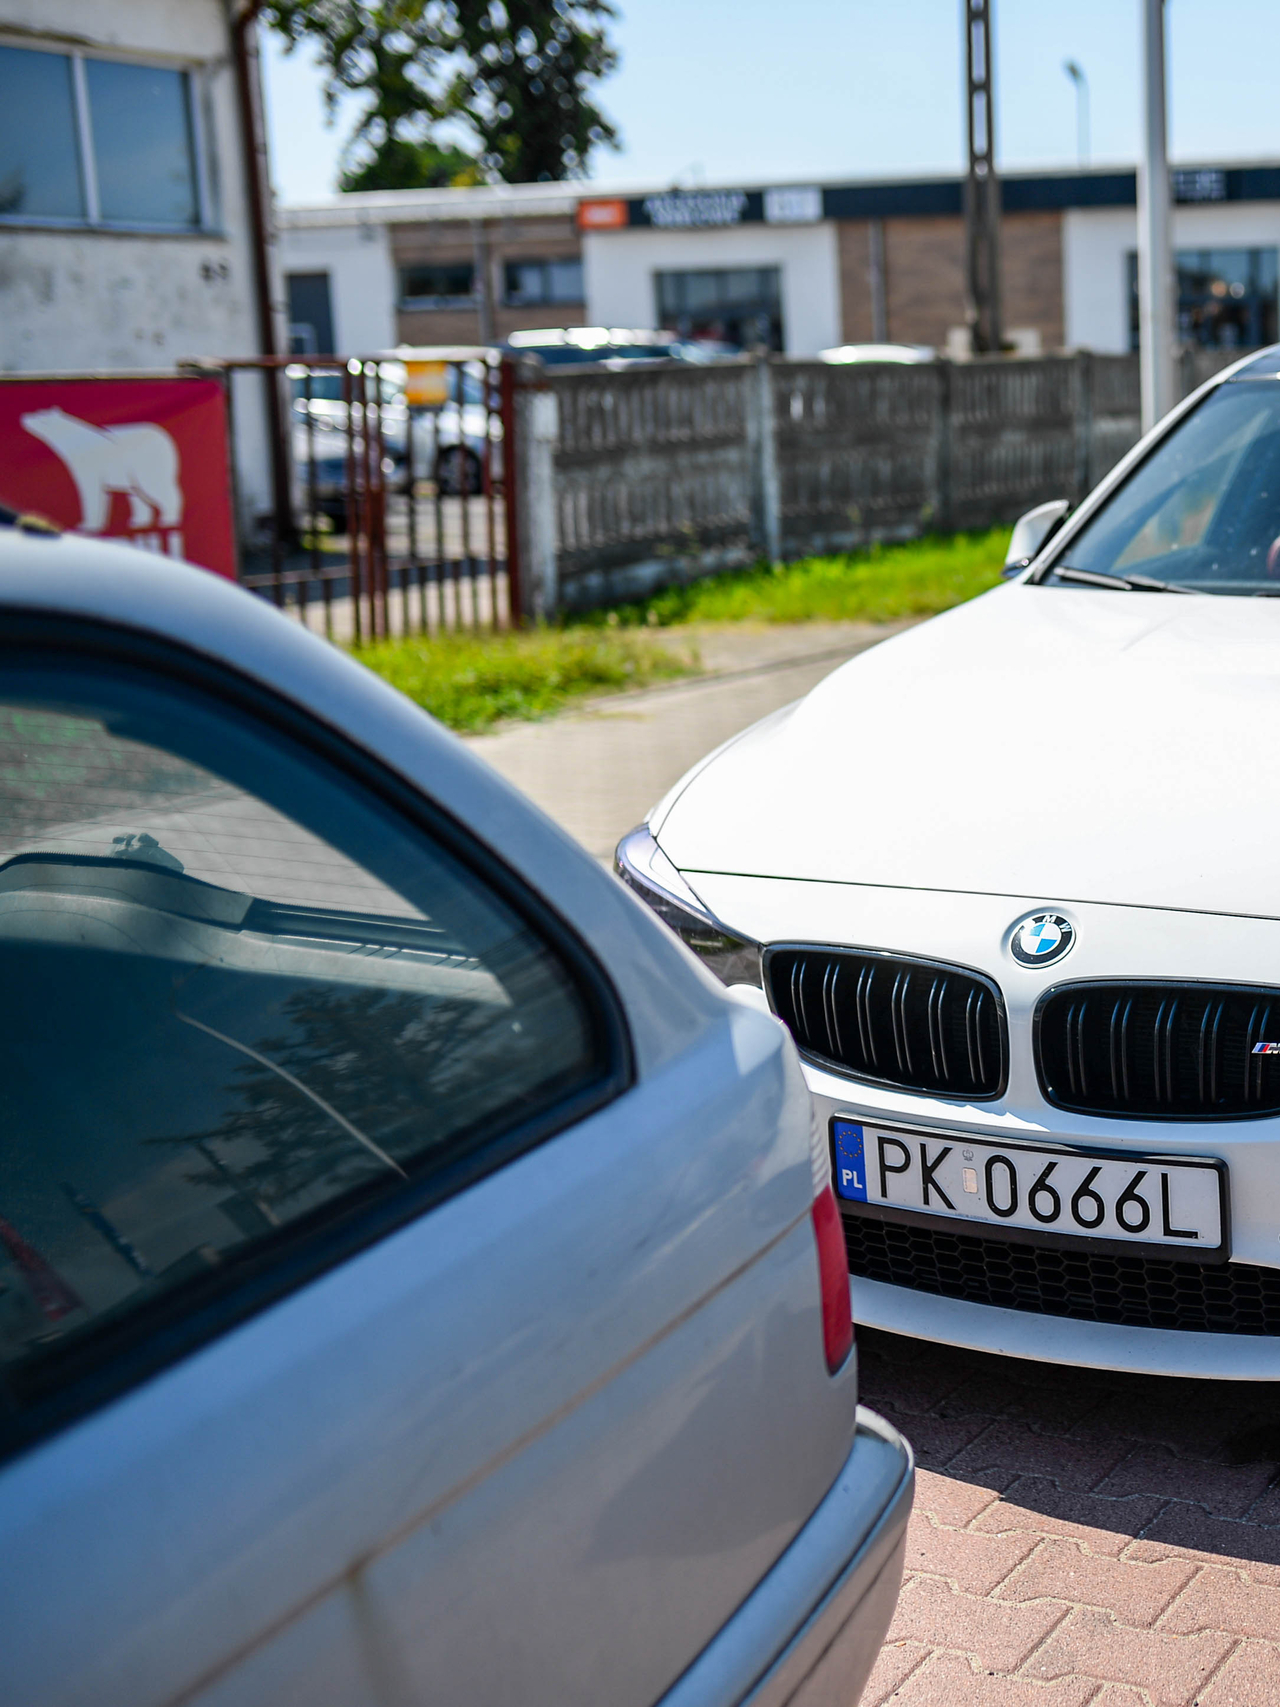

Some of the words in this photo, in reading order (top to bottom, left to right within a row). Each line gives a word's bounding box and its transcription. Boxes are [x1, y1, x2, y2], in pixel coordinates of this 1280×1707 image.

[842, 1168, 863, 1189] PL
[877, 1136, 957, 1211] PK
[984, 1155, 1200, 1240] 0666L
